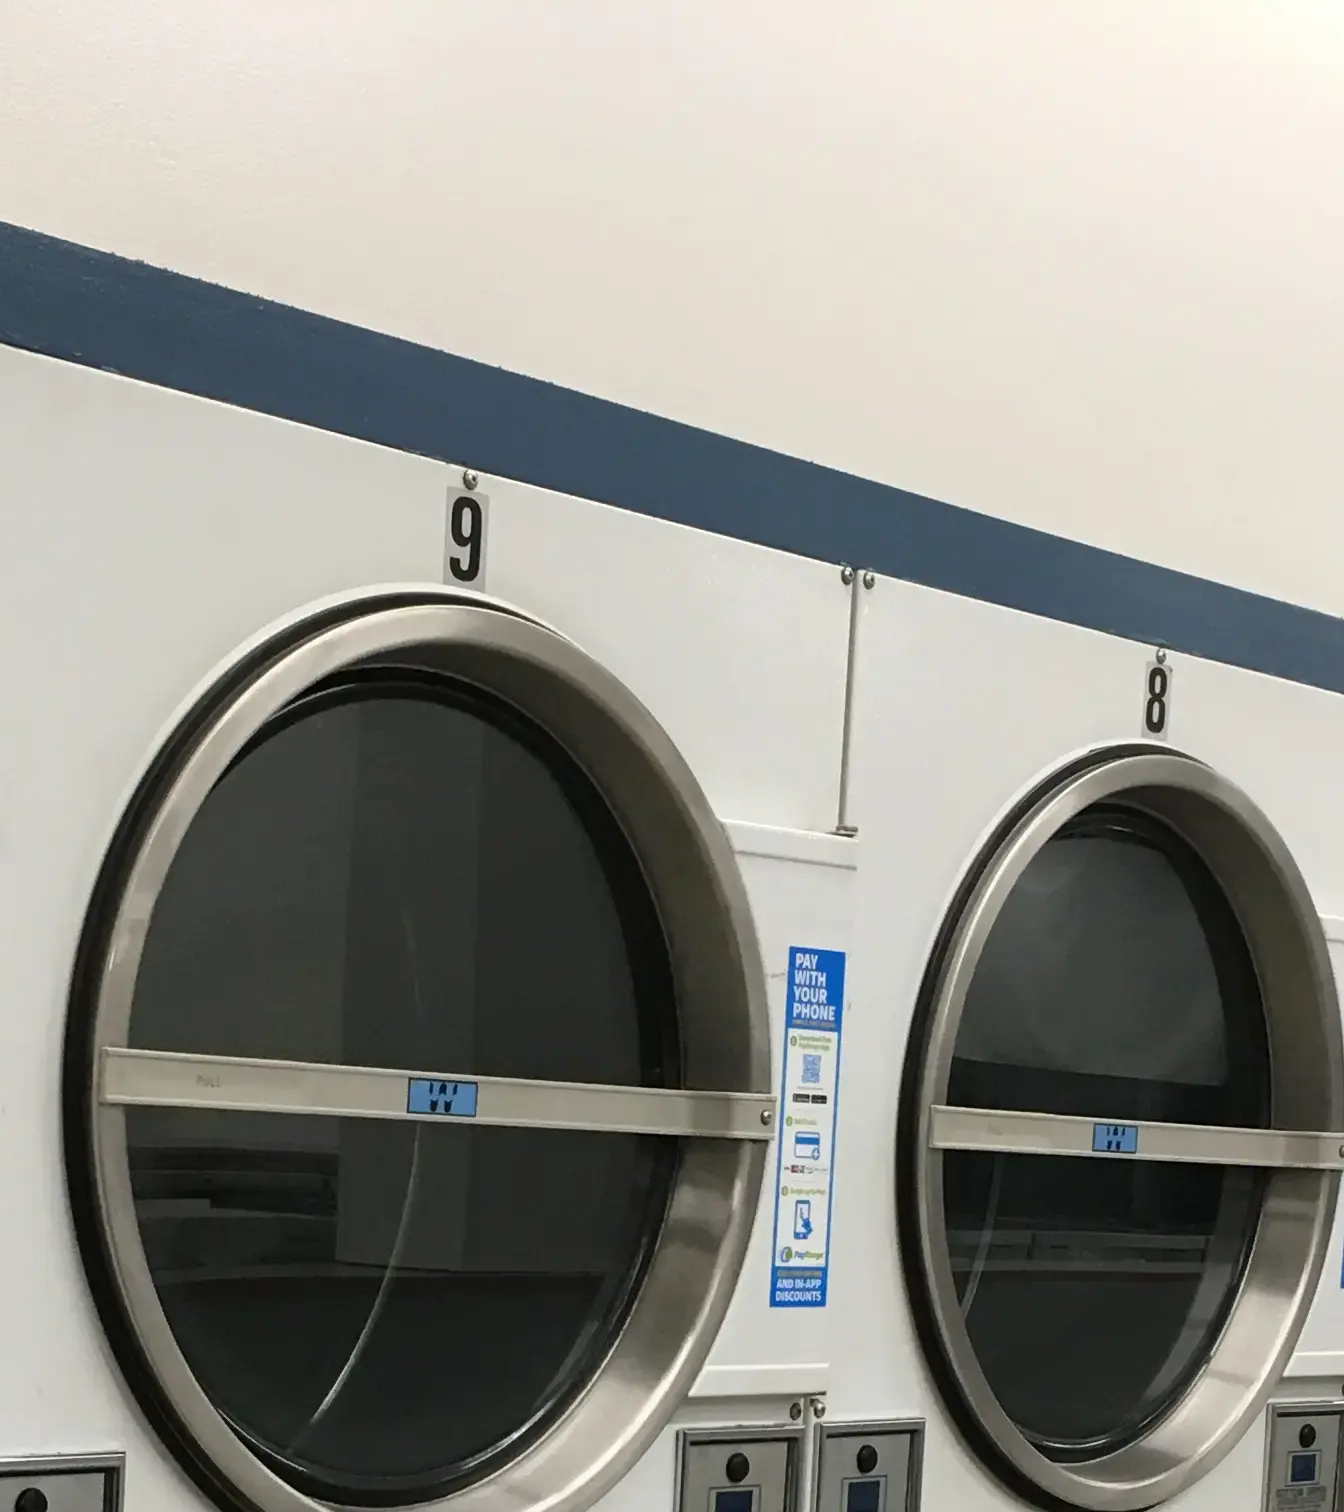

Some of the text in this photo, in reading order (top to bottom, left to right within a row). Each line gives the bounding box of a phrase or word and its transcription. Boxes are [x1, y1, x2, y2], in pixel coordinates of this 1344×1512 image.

[449, 496, 483, 582] 9
[1145, 666, 1168, 734] 8
[794, 952, 820, 971] PAY
[794, 969, 827, 988] WITH
[793, 985, 828, 1004] YOUR
[792, 1000, 836, 1022] PHONE
[776, 1278, 794, 1290] AND
[775, 1289, 823, 1303] DISCOUNTS
